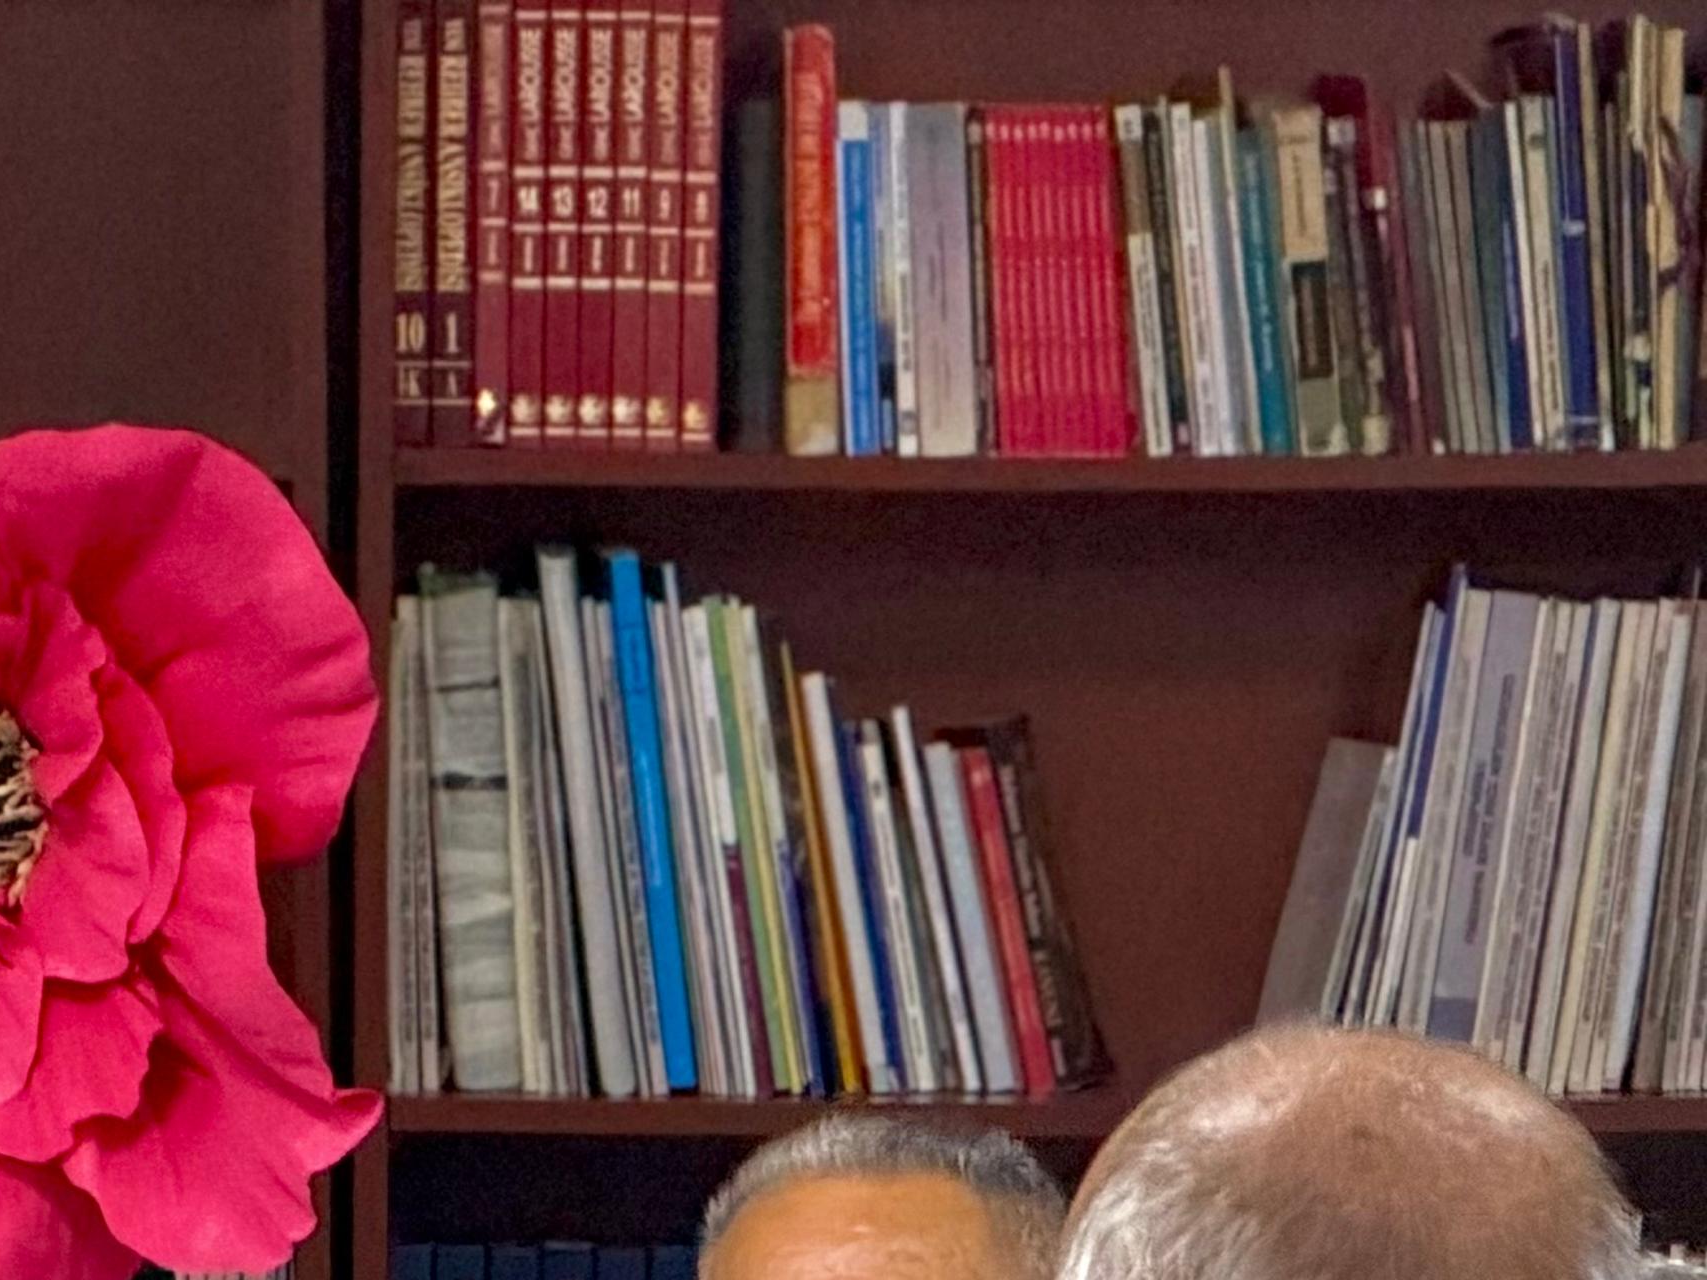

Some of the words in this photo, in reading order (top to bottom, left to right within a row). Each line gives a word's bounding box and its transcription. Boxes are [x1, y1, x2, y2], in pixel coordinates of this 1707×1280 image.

[519, 28, 543, 123] LAROUSSE
[553, 28, 577, 122] LAROUSSE
[588, 29, 613, 122] LAROUSSE
[624, 29, 647, 121] LAROUSSE
[656, 32, 680, 126] LAROUSSE
[690, 35, 714, 128] LAROUSSE
[517, 184, 540, 215] 14
[551, 185, 574, 217] 13
[586, 186, 610, 218] 12
[622, 186, 642, 218] 11
[395, 312, 426, 353] 10
[445, 312, 461, 353] 1
